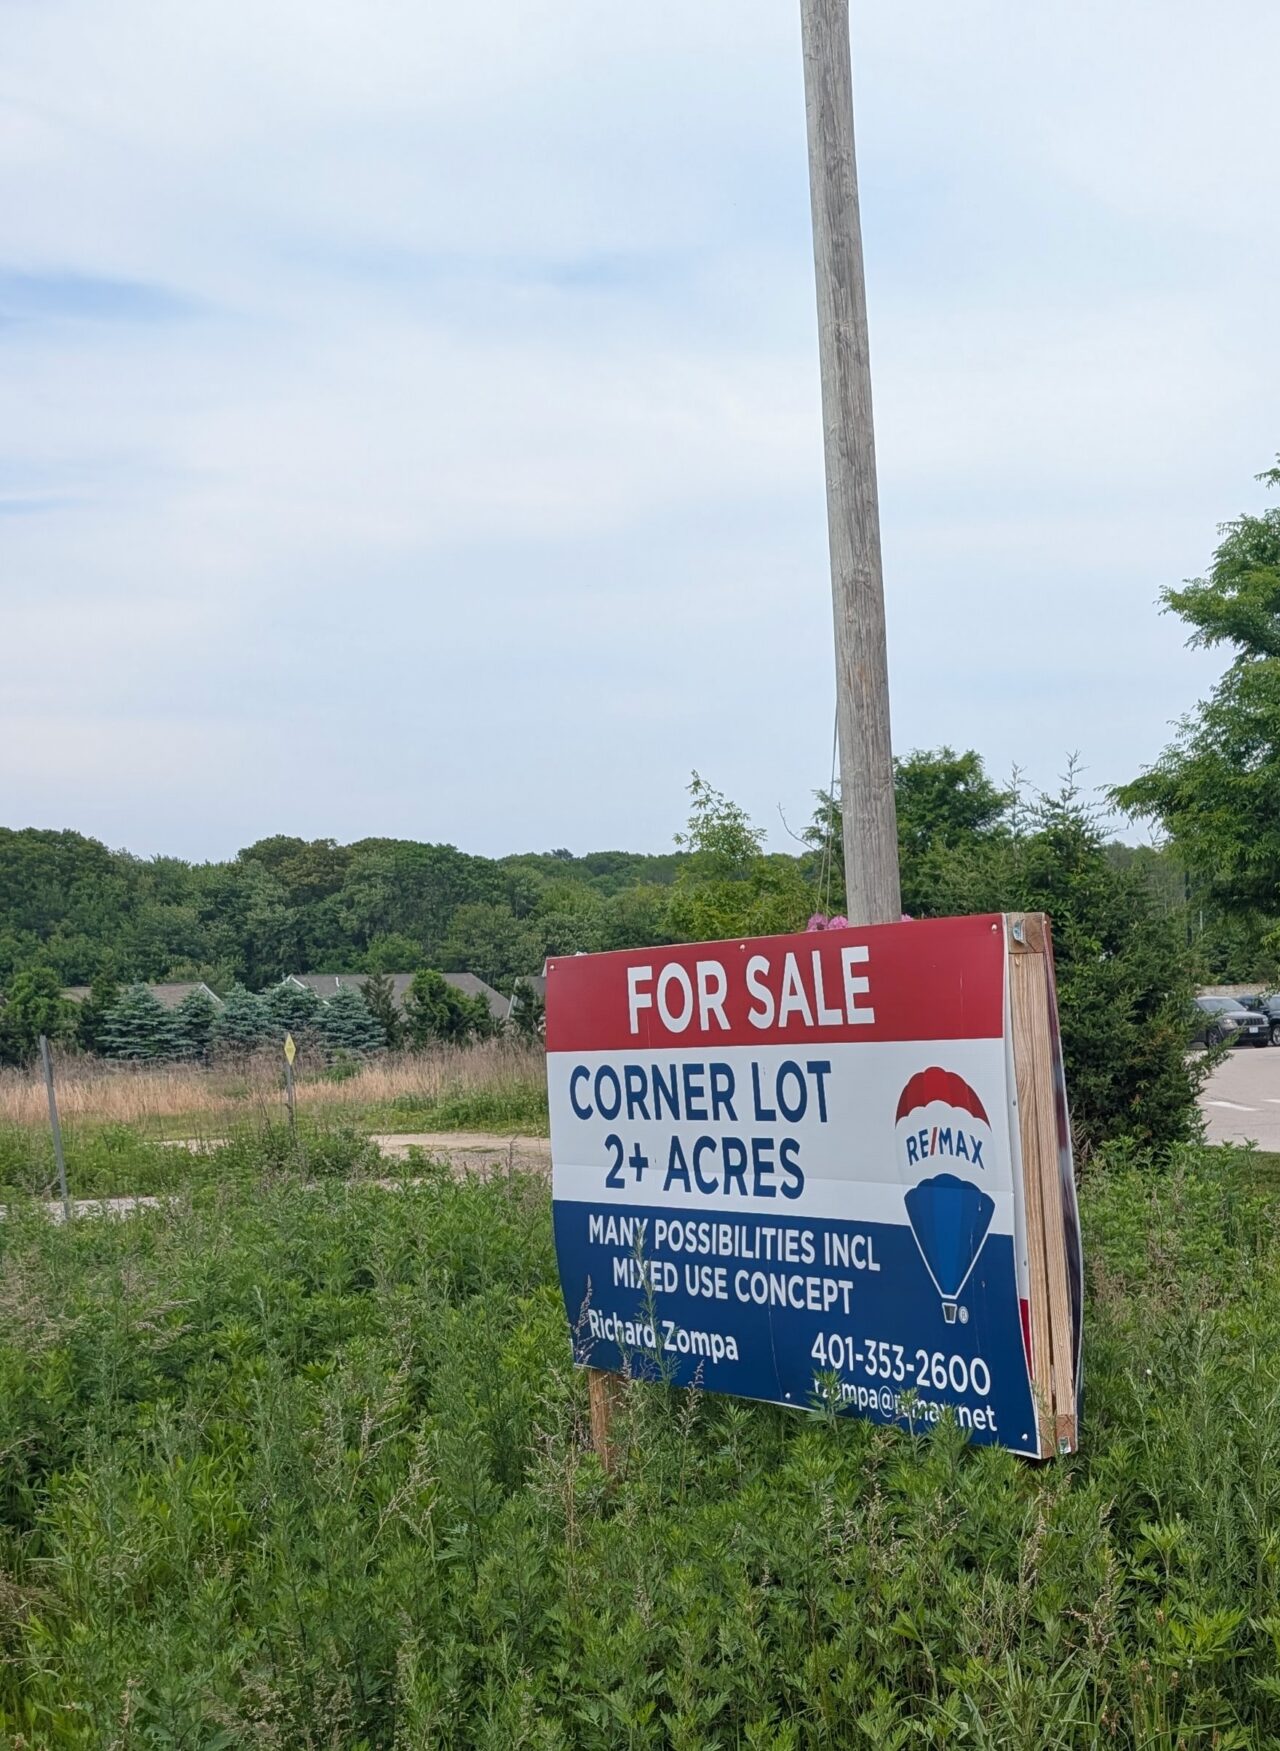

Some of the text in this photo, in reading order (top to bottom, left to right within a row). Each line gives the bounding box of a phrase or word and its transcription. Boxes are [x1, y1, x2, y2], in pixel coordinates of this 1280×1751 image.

[627, 945, 875, 1034] FOR SALE
[569, 1060, 832, 1123] CORNER LOT
[605, 1134, 805, 1200] 2+ ACRES
[906, 1126, 985, 1170] RE/MAX
[588, 1214, 881, 1272] MANY POSSIBILITIES INCL
[612, 1257, 853, 1315] MIXED USE CONCEPT
[588, 1308, 739, 1364] Richard Zompa
[811, 1332, 992, 1396] 401-353-2600
[814, 1378, 998, 1432] rmpa@rma.net
